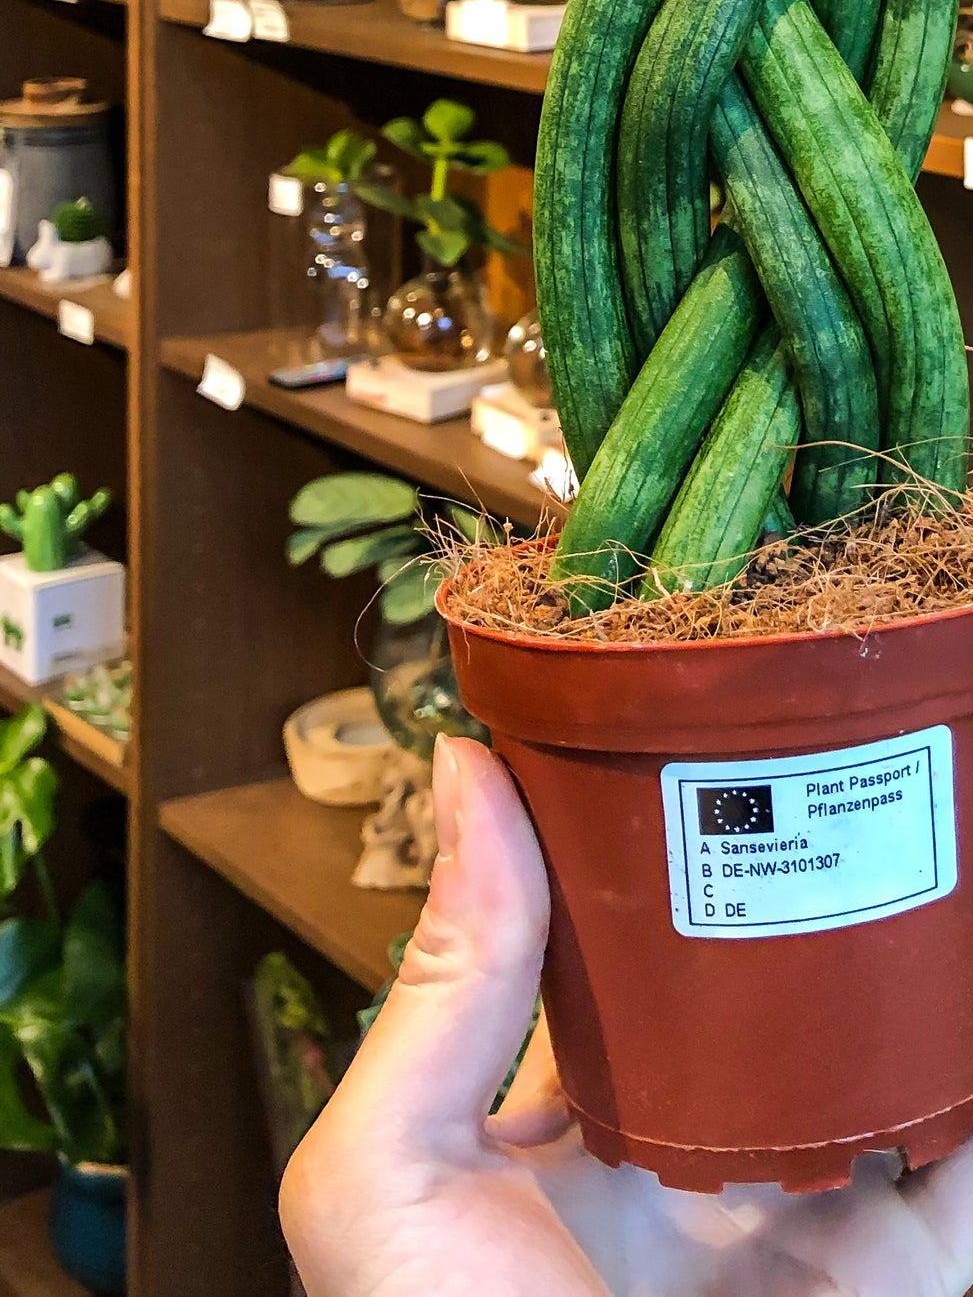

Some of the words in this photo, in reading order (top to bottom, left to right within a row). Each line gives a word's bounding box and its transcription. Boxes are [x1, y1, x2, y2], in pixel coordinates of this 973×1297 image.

[806, 780, 844, 797] Plant
[849, 766, 912, 791] Passport
[808, 790, 903, 818] Pflanzenpass
[700, 842, 711, 855] A
[721, 836, 808, 855] Sansevieria
[702, 864, 712, 878] B
[722, 853, 840, 878] DE-NW-3101307
[704, 884, 714, 898] C
[705, 904, 715, 917] D
[725, 903, 747, 917] DE
